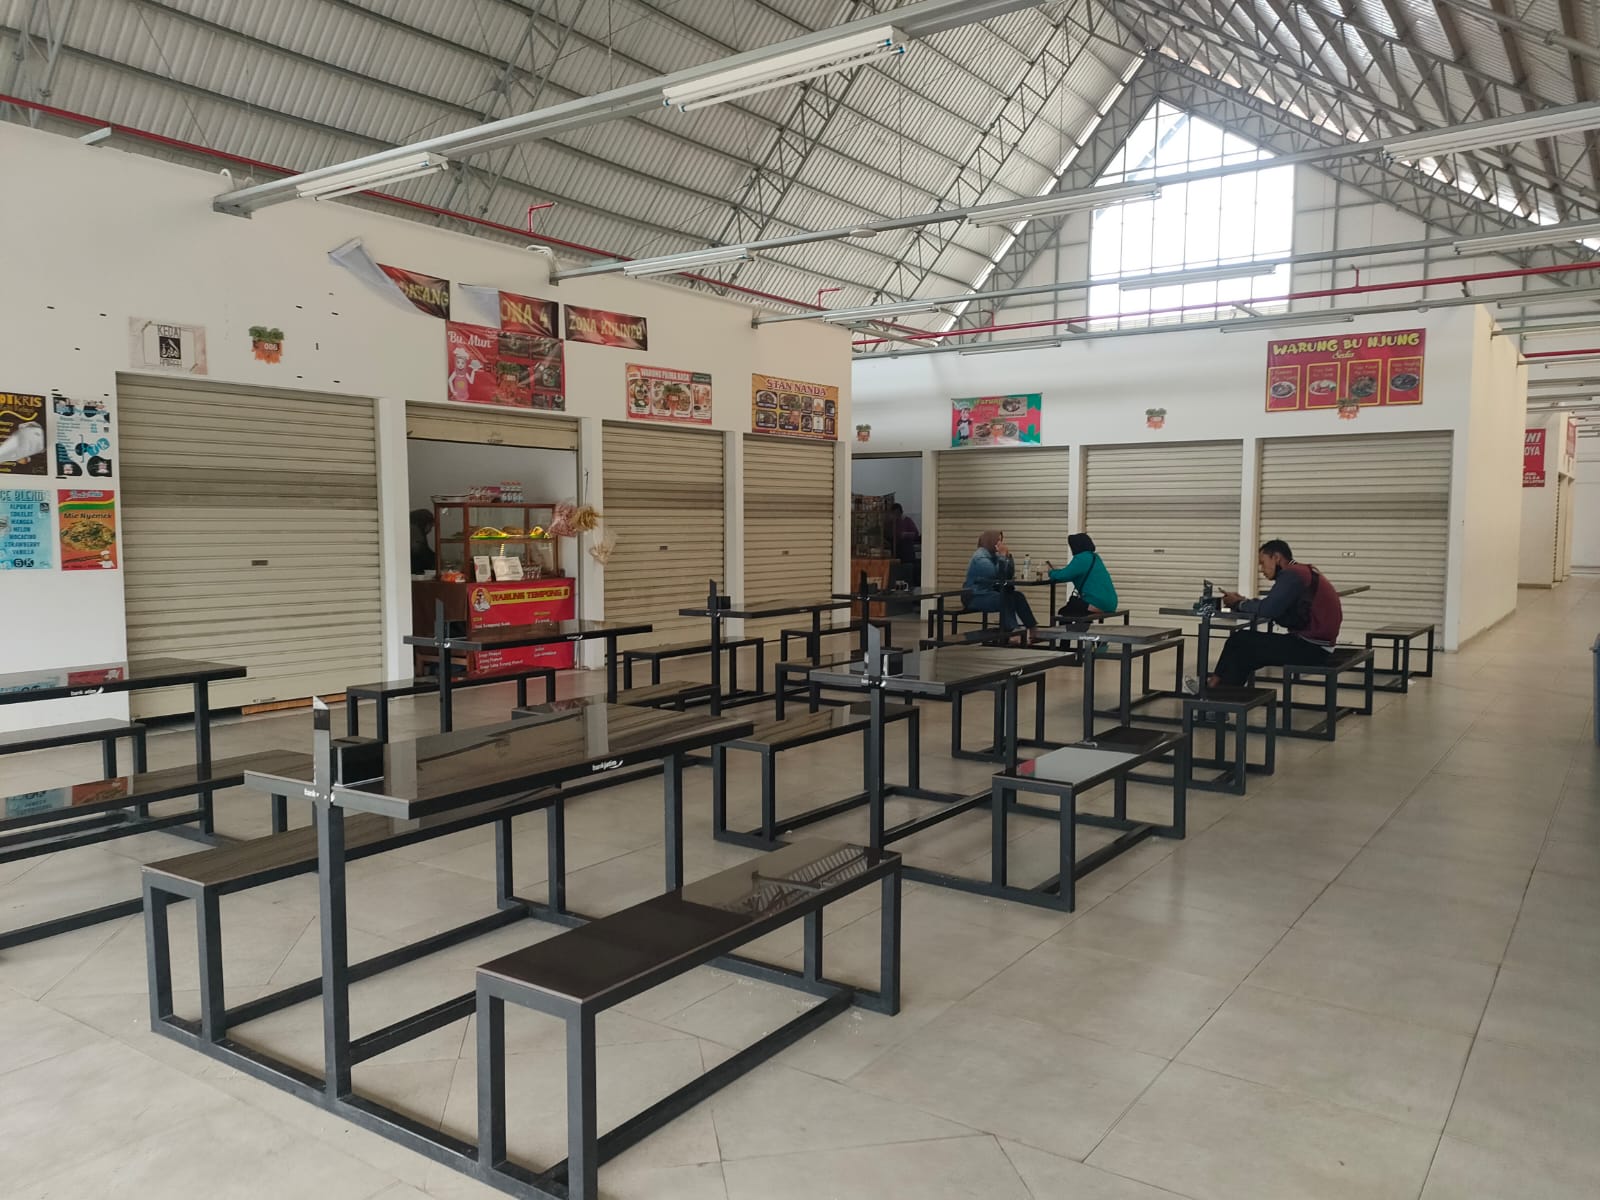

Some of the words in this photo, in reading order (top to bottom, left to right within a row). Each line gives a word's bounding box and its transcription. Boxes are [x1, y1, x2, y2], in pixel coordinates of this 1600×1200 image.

[569, 315, 597, 332] ZONA
[1273, 340, 1338, 355] WARUNG
[1343, 338, 1362, 350] BU
[1367, 332, 1419, 348] NJUNG
[767, 379, 791, 390] STAN
[794, 383, 827, 396] NANDA
